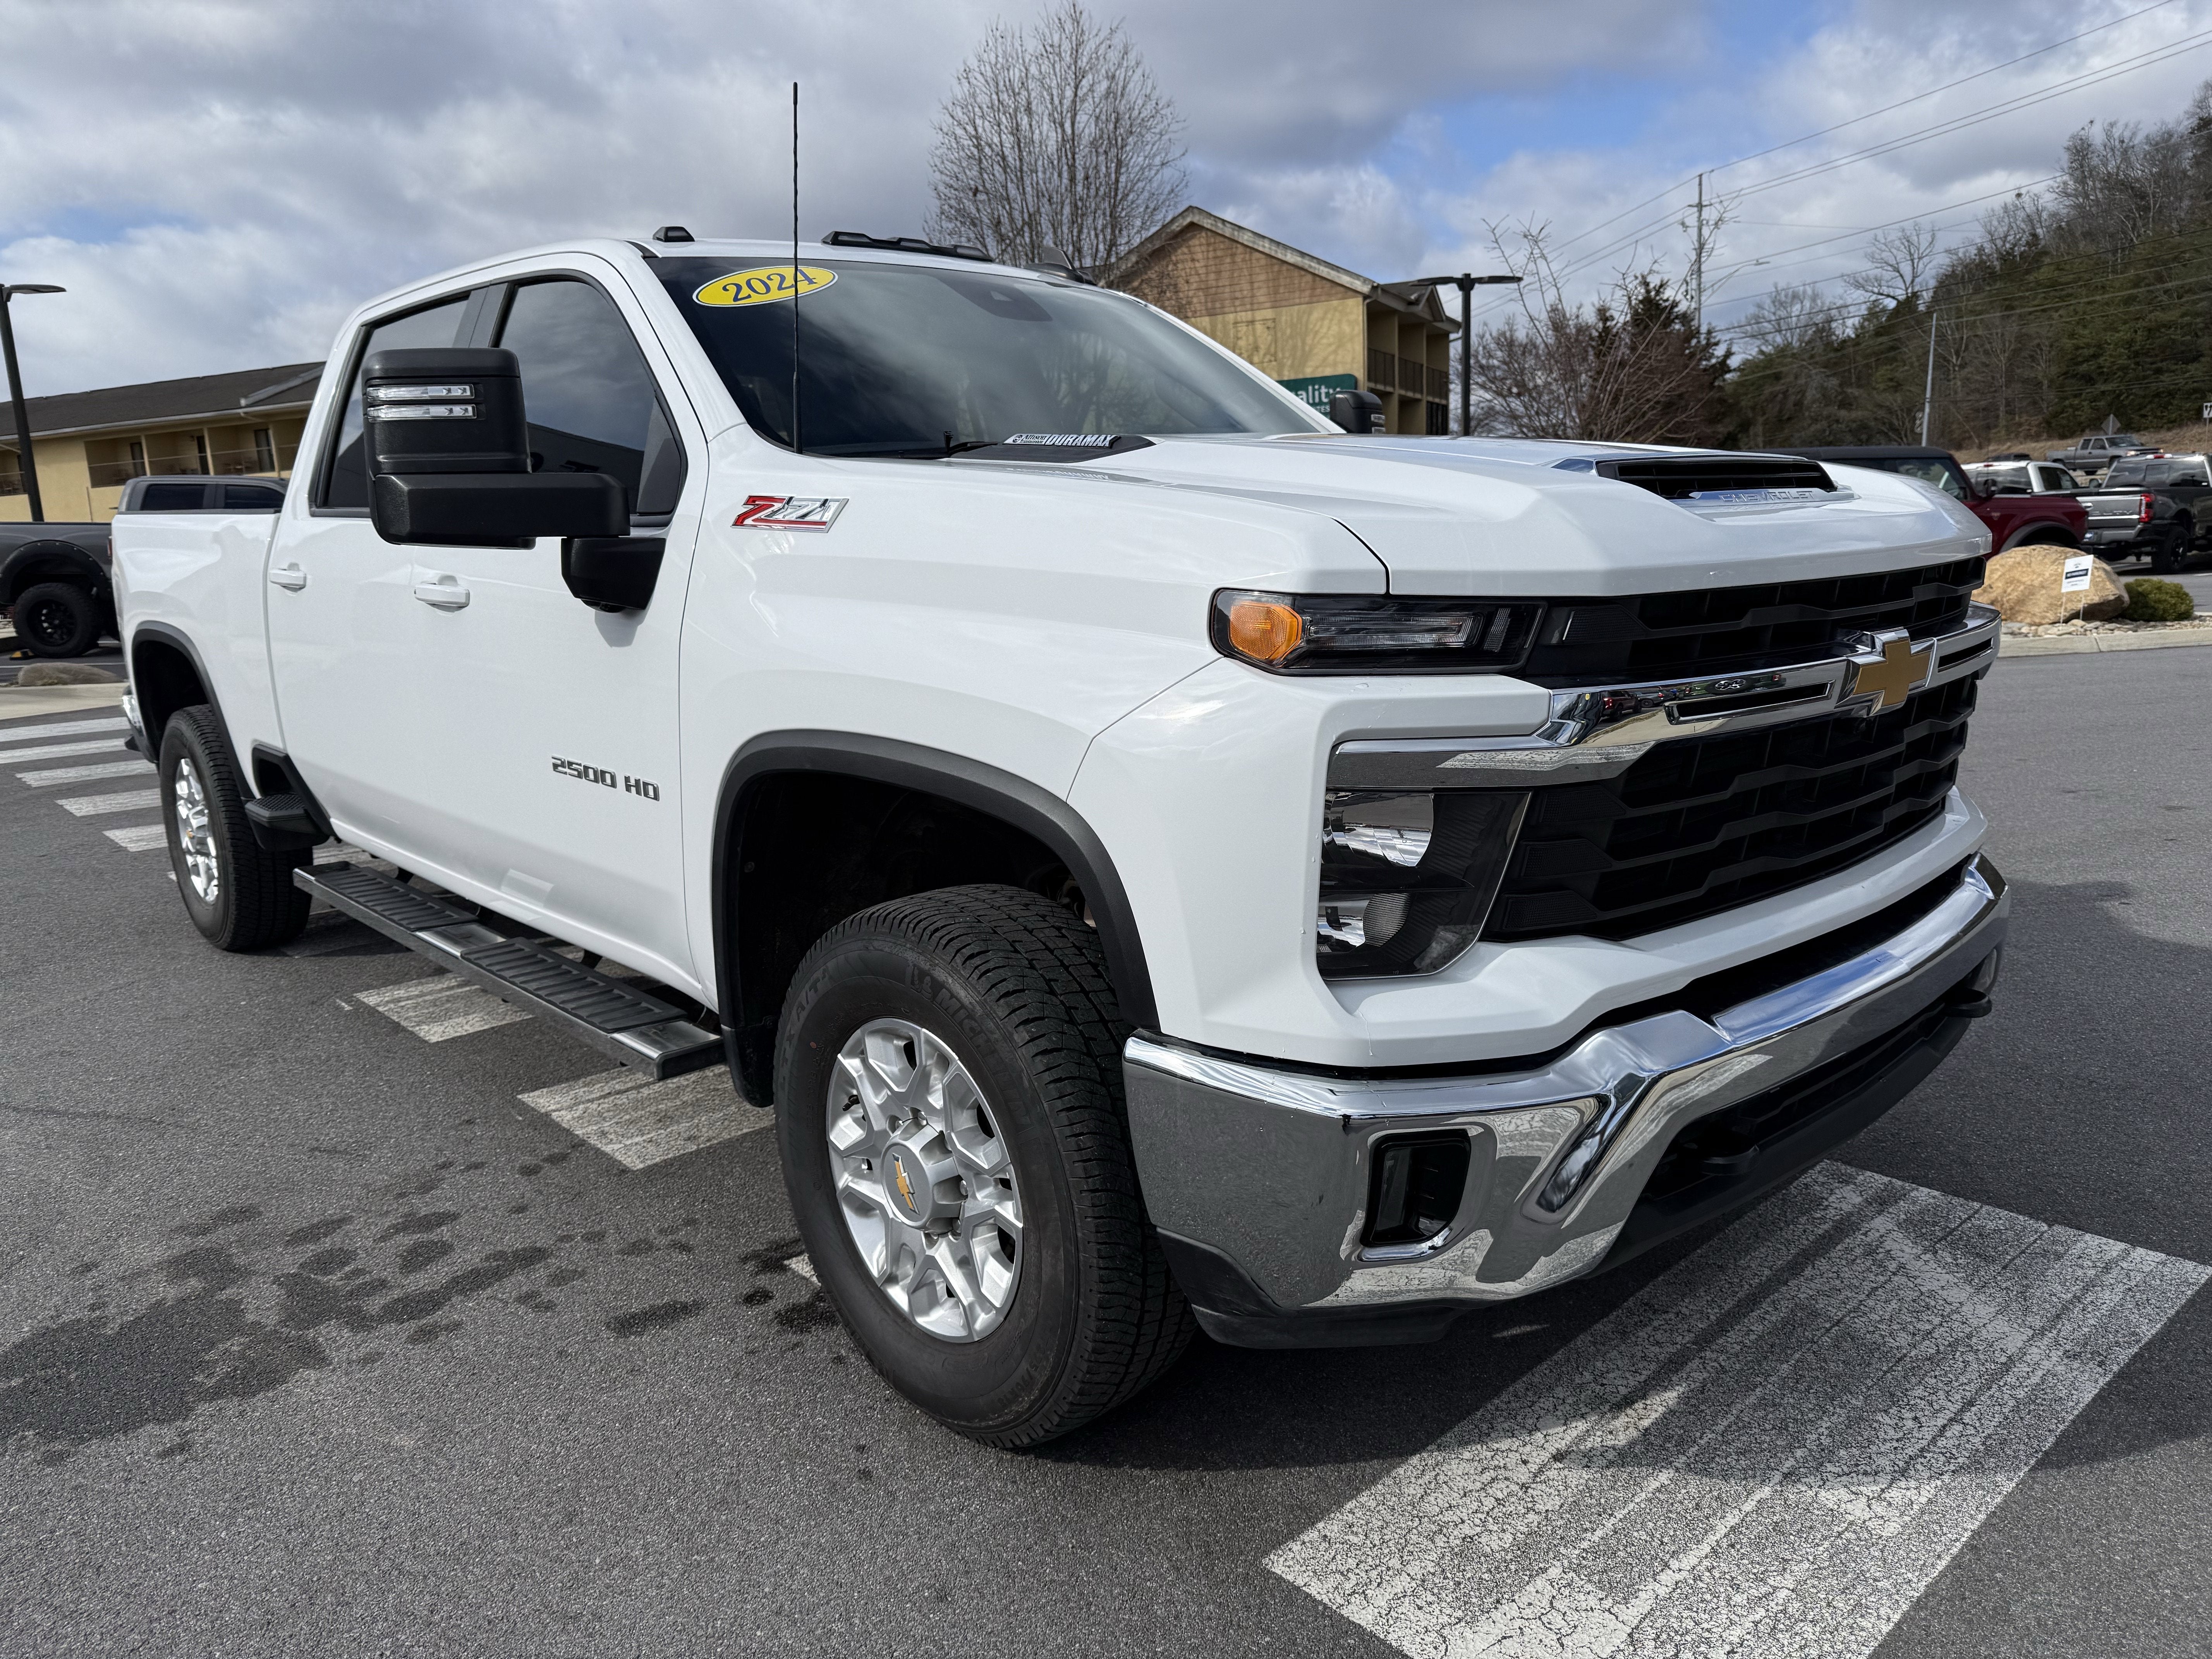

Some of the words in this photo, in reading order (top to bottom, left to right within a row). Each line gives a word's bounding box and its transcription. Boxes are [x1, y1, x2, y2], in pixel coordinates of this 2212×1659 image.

[722, 269, 818, 302] 2024
[1044, 434, 1118, 448] DURAMAX
[1718, 490, 1814, 503] CHEVROLET
[730, 495, 849, 533] Z71
[551, 755, 617, 789] 2500
[624, 775, 660, 802] HD
